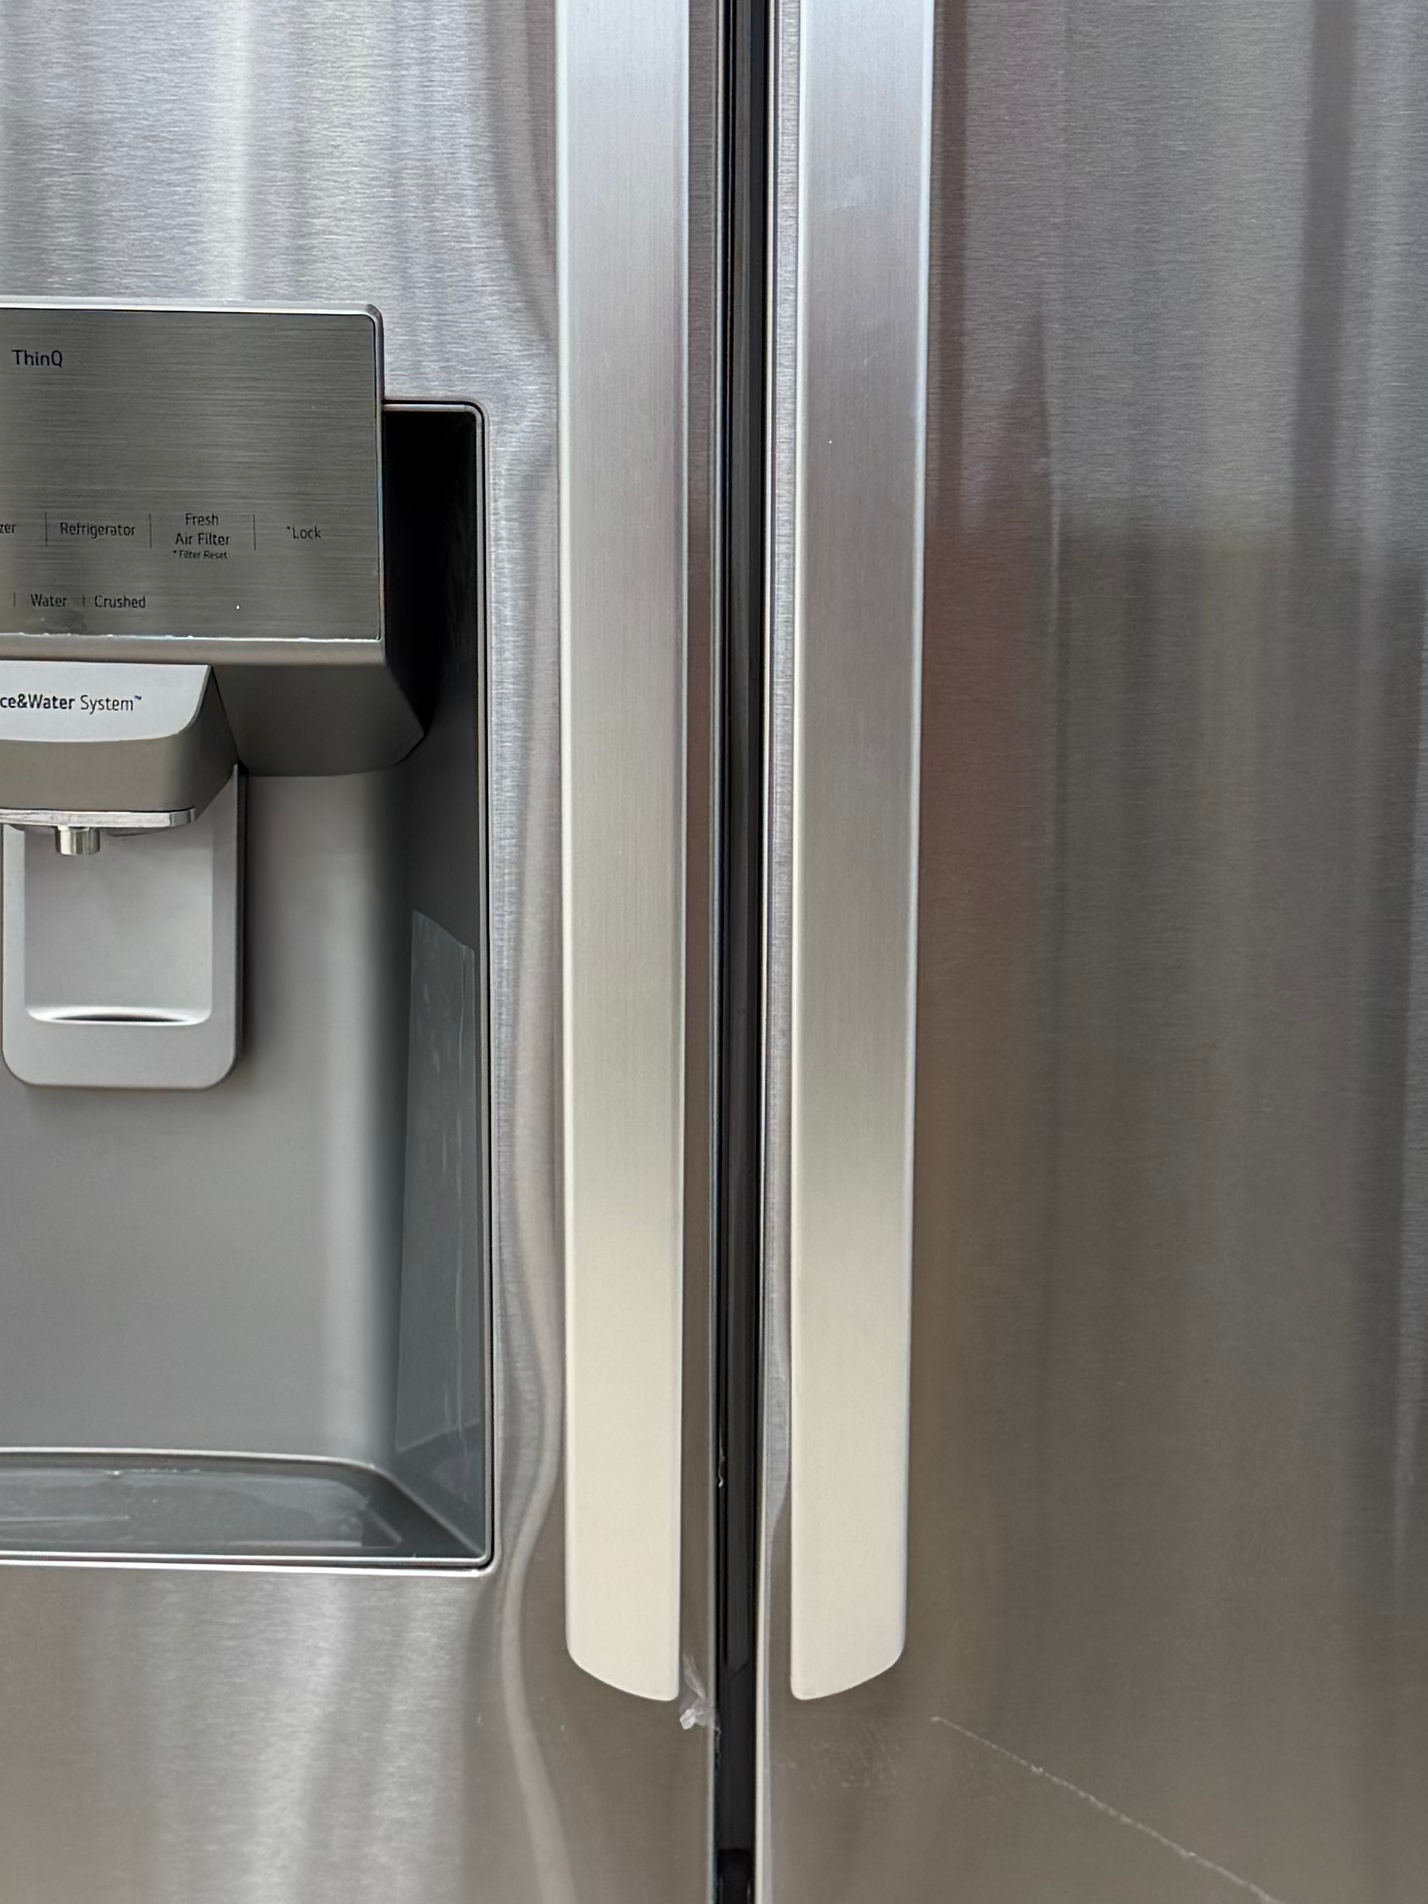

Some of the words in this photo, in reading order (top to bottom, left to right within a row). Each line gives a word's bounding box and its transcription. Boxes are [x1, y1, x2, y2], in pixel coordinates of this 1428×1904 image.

[11, 349, 63, 368] ThinQ
[185, 512, 219, 526] Fresh
[60, 522, 136, 539] Refrigerator
[292, 526, 322, 540] Lock
[175, 532, 193, 545] Air
[198, 533, 230, 546] Filter
[179, 550, 201, 559] Filter
[204, 550, 228, 560] Reset
[30, 593, 67, 607] Water
[94, 595, 146, 609] Crushed
